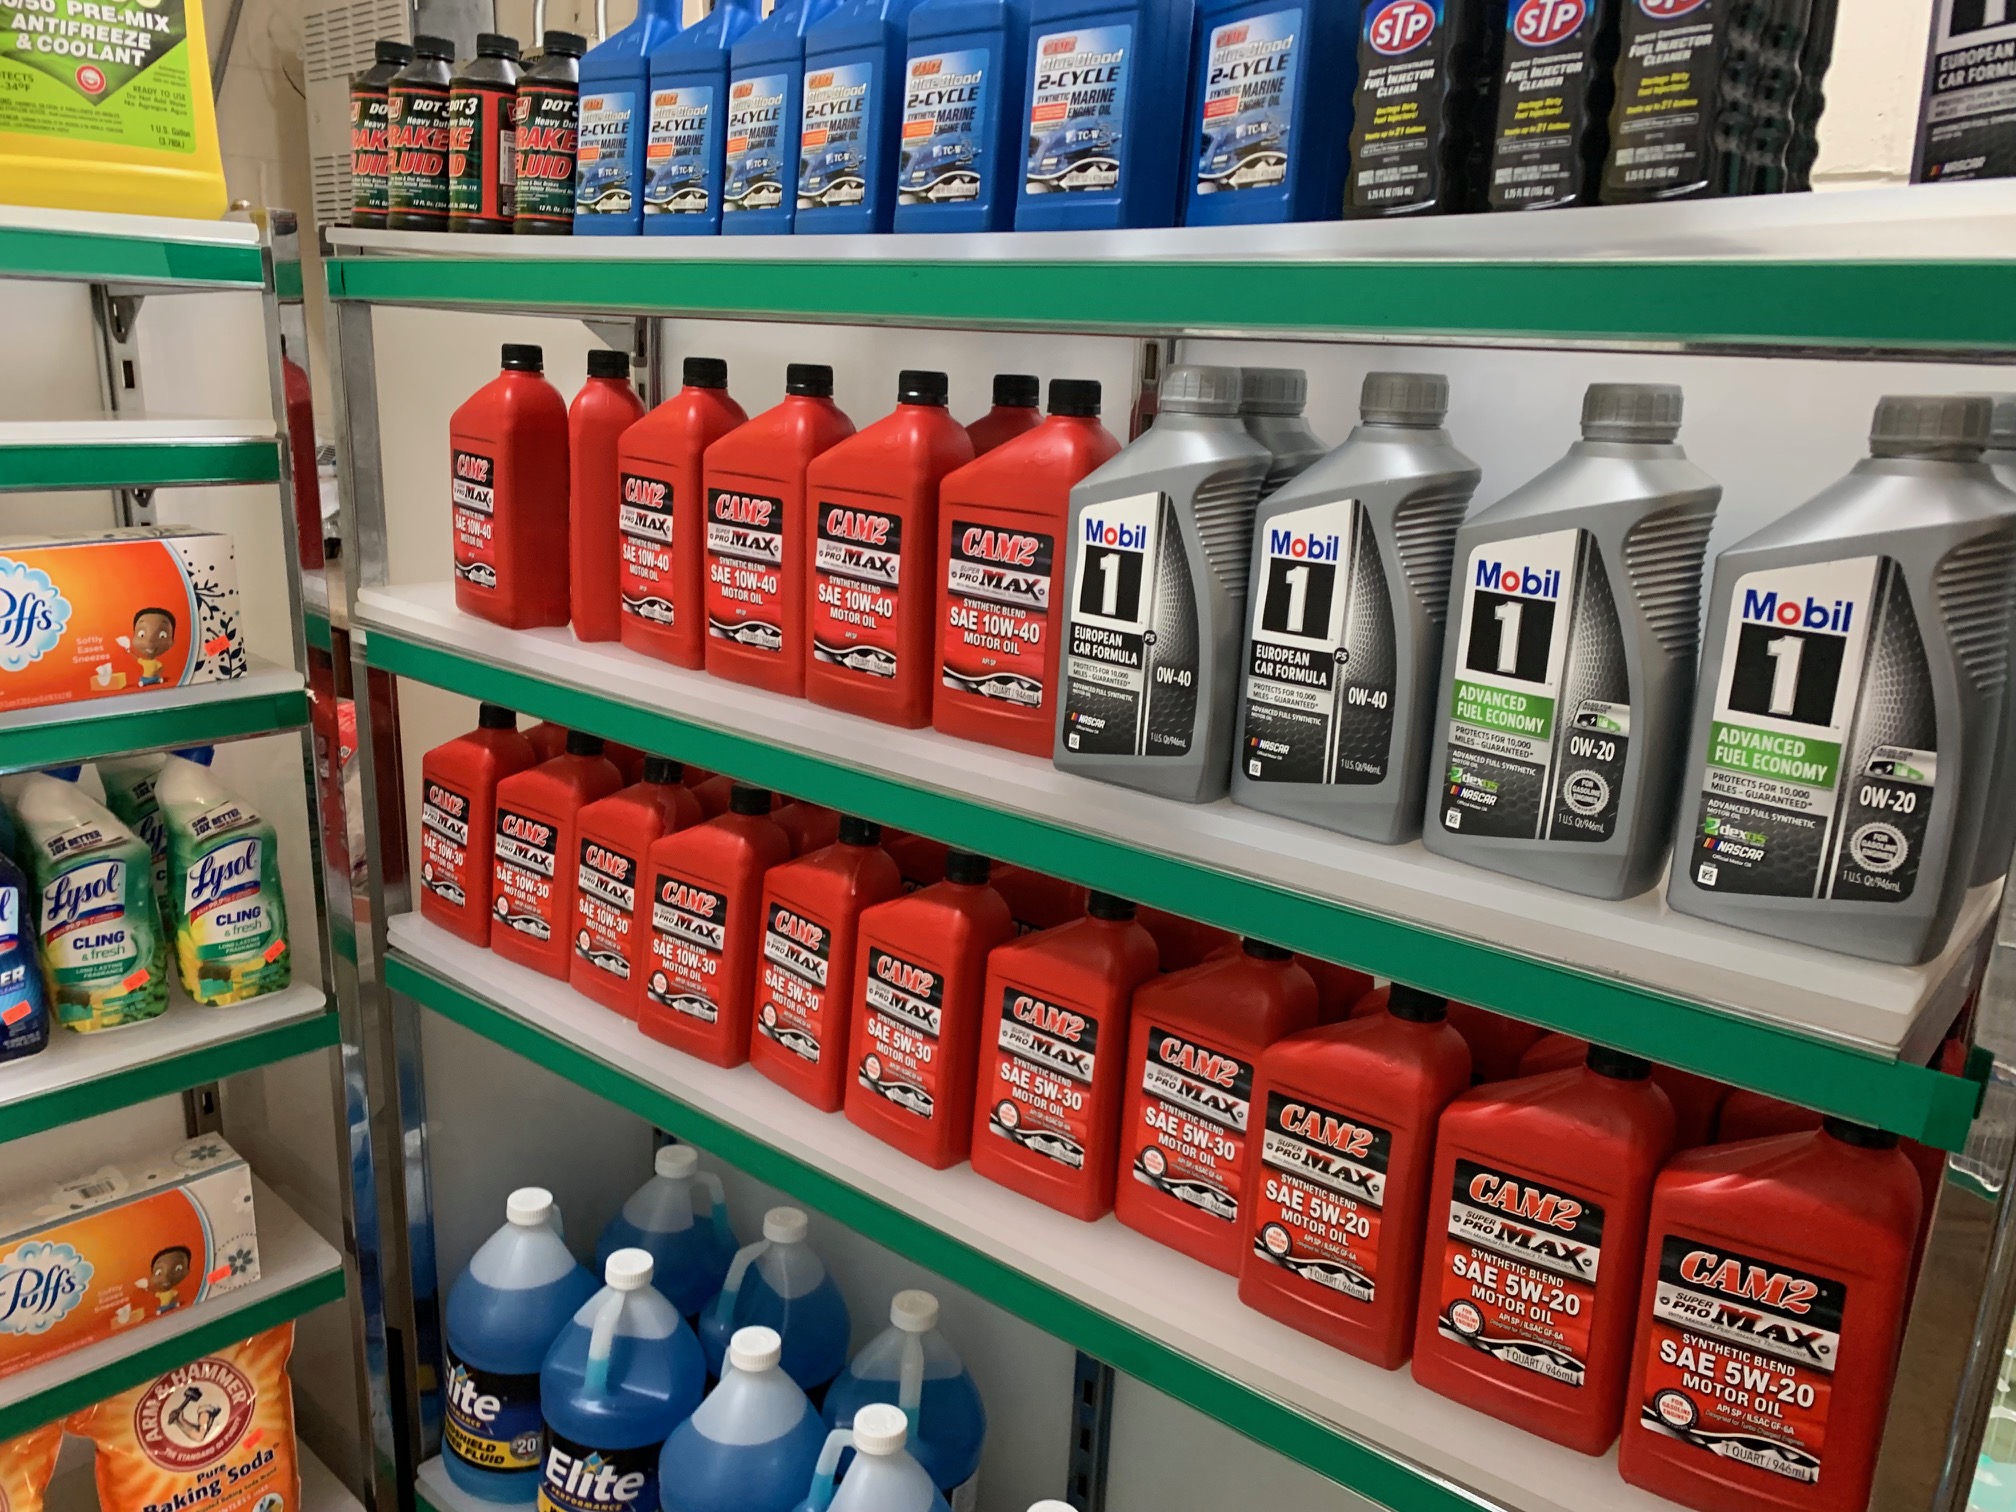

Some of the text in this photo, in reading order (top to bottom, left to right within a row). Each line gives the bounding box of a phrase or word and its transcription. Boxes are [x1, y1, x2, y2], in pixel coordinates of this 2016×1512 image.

[11, 13, 151, 49] ANTIFREEZE
[67, 0, 170, 33] PRE-MIX
[1376, 4, 1428, 47] STP
[1520, 0, 1577, 37] STP
[16, 33, 146, 67] & COOLANT
[1941, 41, 2015, 72] EUROPEAN
[1037, 66, 1120, 90] 2-CYCLE
[1210, 53, 1288, 84] 2-CYCLE
[1363, 68, 1434, 91] FUEL INJECTOR
[1505, 62, 1582, 84] FUEL INJECTOR
[1939, 69, 1965, 89] CAR
[133, 85, 186, 101] READY TO USE
[907, 86, 979, 108] 2-CYCLE
[1037, 87, 1115, 105] SYNTHETIC MARINE
[1240, 77, 1284, 99] MARINE
[1376, 83, 1418, 98] CLEANER
[1519, 77, 1563, 92] CLEANER
[413, 100, 441, 111] DOT
[541, 99, 570, 111] DOT
[730, 108, 779, 127] 2-CYCLE
[806, 98, 863, 119] 2-CYCLE
[907, 107, 975, 122] SYNTHETIC MARINE
[1067, 105, 1111, 119] ENGINE OIL
[171, 128, 191, 138] Gallon
[406, 116, 430, 127] Heavy
[534, 116, 559, 127] Heavy
[581, 122, 628, 136] 2-CYCLE
[652, 118, 706, 133] 2-CYCLE
[748, 125, 778, 139] MARINE
[829, 117, 861, 132] MARINE
[601, 138, 627, 149] MARINE
[675, 134, 703, 146] MARINE
[457, 454, 489, 482] CAM2
[625, 478, 664, 508] CAM2
[716, 494, 772, 526] CAM2
[456, 514, 491, 540] SAE 10W-40
[827, 509, 890, 545] CAM2
[1086, 518, 1147, 549] Mobil
[623, 543, 669, 571] SAE 10W-40
[963, 527, 1039, 567] CAM2
[1271, 529, 1339, 561] Mobil
[710, 564, 776, 594] SAE 10W-40
[1100, 553, 1120, 616] 1
[1475, 559, 1560, 598] Mobil
[722, 586, 763, 605] MOTOR OIL
[819, 583, 892, 617] SAE 10W-40
[1286, 566, 1310, 632] 1
[1743, 589, 1853, 632] Mobil
[830, 607, 876, 629] MOTOR OIL
[950, 606, 1039, 644] SAE 10W-40
[76, 636, 103, 645] Softly
[77, 645, 104, 654] Eases
[964, 631, 1020, 655] MOTOR OIL
[1074, 625, 1122, 647] EUROPEAN
[1495, 601, 1523, 674] 1
[73, 653, 110, 664] Sneezes
[1073, 640, 1137, 666] CAR FORMULA
[1157, 666, 1191, 687] 0W-40
[1767, 635, 1805, 715] 1
[1349, 687, 1387, 709] 0W-40
[1458, 684, 1526, 711] ADVANCED
[1457, 701, 1544, 734] FUEL ECONOMY
[1570, 735, 1615, 762] 0W-20
[429, 785, 464, 817] CAM2
[1713, 772, 1810, 799] PROTECTS FOR 10,000
[1861, 785, 1916, 813] 0W-20
[502, 814, 550, 847] CAM2
[424, 834, 463, 866] SAE 10W-30
[585, 845, 628, 880] CAM2
[1717, 841, 1764, 861] NASCAR
[190, 840, 256, 899] Lysol
[496, 864, 549, 898] SAE 10W-30
[44, 864, 119, 920] Lysol
[662, 881, 716, 917] CAM2
[216, 906, 261, 927] CLING
[233, 920, 262, 935] fresh
[579, 898, 628, 934] SAE 10W-30
[775, 910, 822, 950] CAM2
[72, 931, 125, 950] CLING
[90, 946, 125, 960] fresh
[653, 939, 716, 975] SAE 10W-30
[765, 969, 819, 1012] SAE 5W-30
[877, 955, 934, 998] CAM2
[1013, 997, 1086, 1042] CAM2
[867, 1018, 932, 1063] SAE 5W-30
[1160, 1038, 1239, 1087] CAM2
[1001, 1062, 1082, 1111] SAE 5W-30
[1145, 1106, 1235, 1160] SAE 5W-30
[1280, 1104, 1373, 1158] CAM2
[1266, 1180, 1370, 1238] SAE 5W-20
[1469, 1173, 1582, 1231] CAM2
[0, 1264, 76, 1322] Puffs
[1452, 1254, 1580, 1315] SAE 5W-20
[1680, 1250, 1818, 1314] CAM2
[1676, 1292, 1713, 1309] SUPER
[1672, 1301, 1823, 1361] PRO MAX
[1683, 1333, 1795, 1377] SYNTHETIC BLEND
[1660, 1339, 1814, 1408] SAE 5W-20
[143, 1400, 163, 1442] ARM
[170, 1363, 246, 1405] HAMMER
[1683, 1373, 1783, 1418] MOTOR OIL
[227, 1450, 274, 1484] Soda
[464, 1447, 504, 1464] FLUID
[1732, 1445, 1764, 1466] QUART
[1773, 1459, 1807, 1478] 946mL
[196, 1464, 226, 1483] Pure
[546, 1446, 644, 1501] Elite
